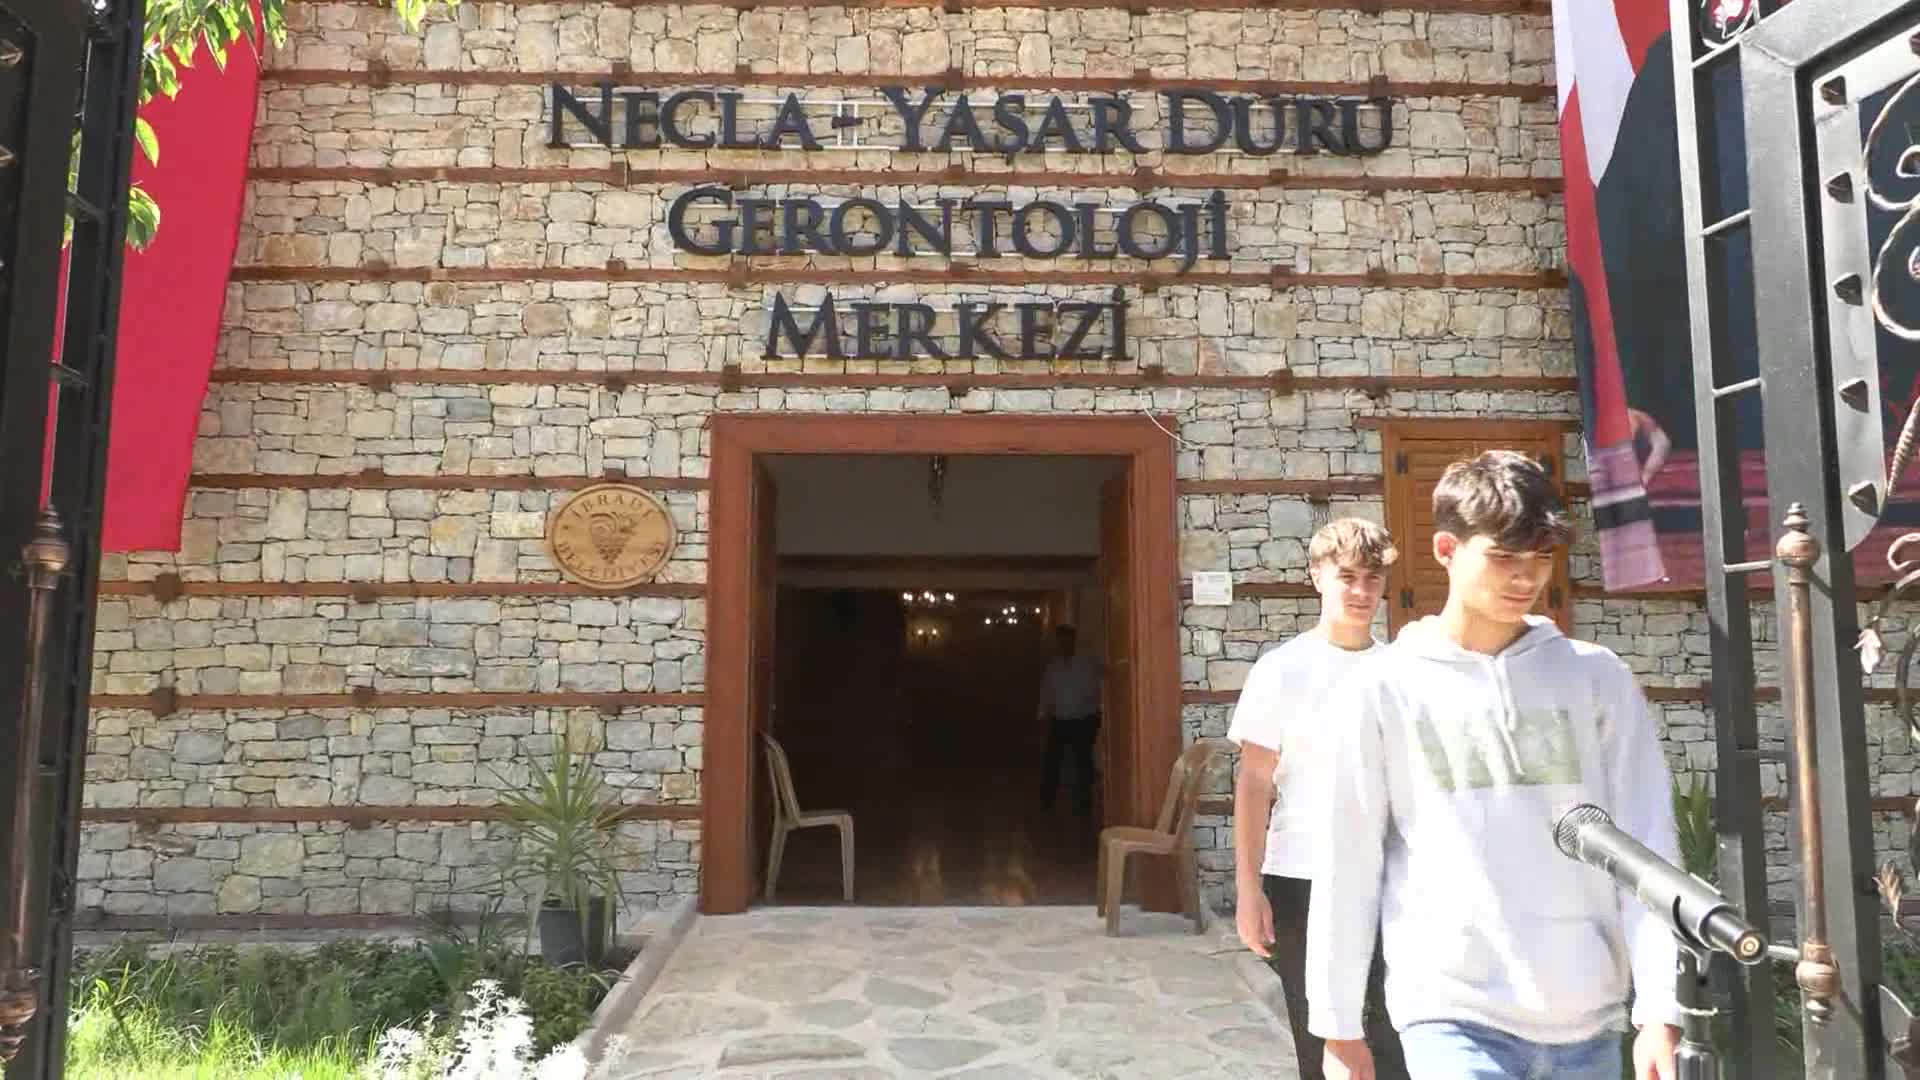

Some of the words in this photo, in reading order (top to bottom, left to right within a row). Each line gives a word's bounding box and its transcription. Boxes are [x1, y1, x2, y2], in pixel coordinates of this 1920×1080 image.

[547, 82, 824, 151] NECLA
[1163, 88, 1395, 157] DURU
[668, 186, 1231, 274] GERONTOLOJİ
[760, 286, 1133, 362] MERKEZİ
